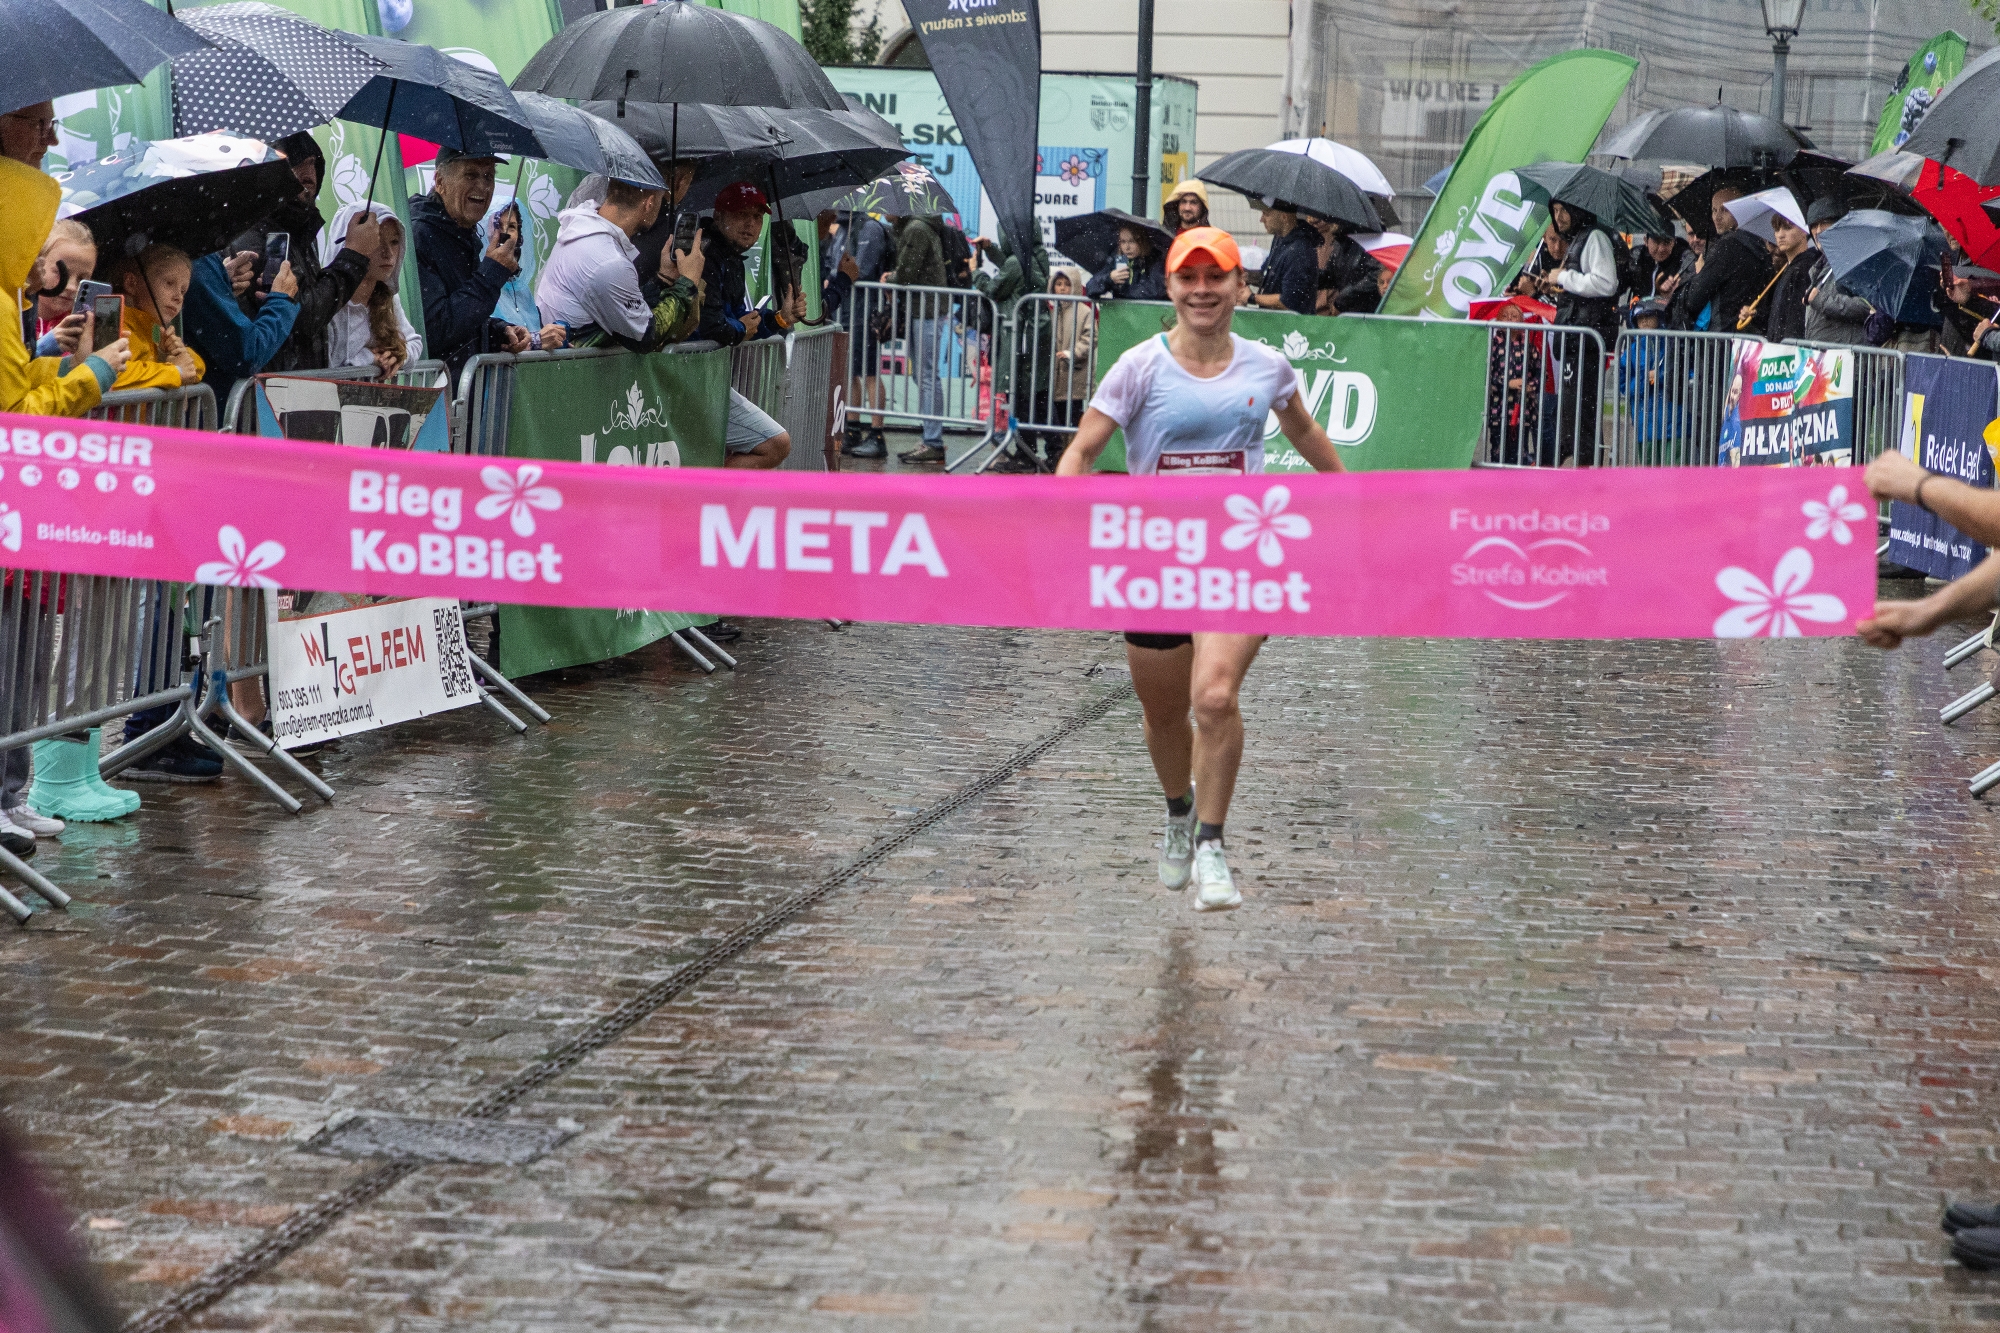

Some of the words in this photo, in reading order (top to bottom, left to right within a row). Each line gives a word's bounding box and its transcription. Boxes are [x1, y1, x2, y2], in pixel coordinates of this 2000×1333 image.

[1390, 80, 1481, 102] WOLNE
[1742, 422, 1790, 456] PIŁKA
[1790, 409, 1840, 458] ĘCZNA
[1925, 434, 1959, 475] Radek
[349, 469, 463, 531] Bieg
[1449, 507, 1611, 538] Fundacja
[350, 528, 563, 584] KoBBiet
[700, 503, 949, 578] META
[1089, 503, 1208, 564] Bieg
[1089, 564, 1311, 613] KoBBiet
[1451, 562, 1526, 586] Strefa
[1530, 563, 1608, 586] Kobiet
[348, 624, 426, 678] ELREM
[291, 687, 309, 708] 395
[308, 683, 323, 704] 111
